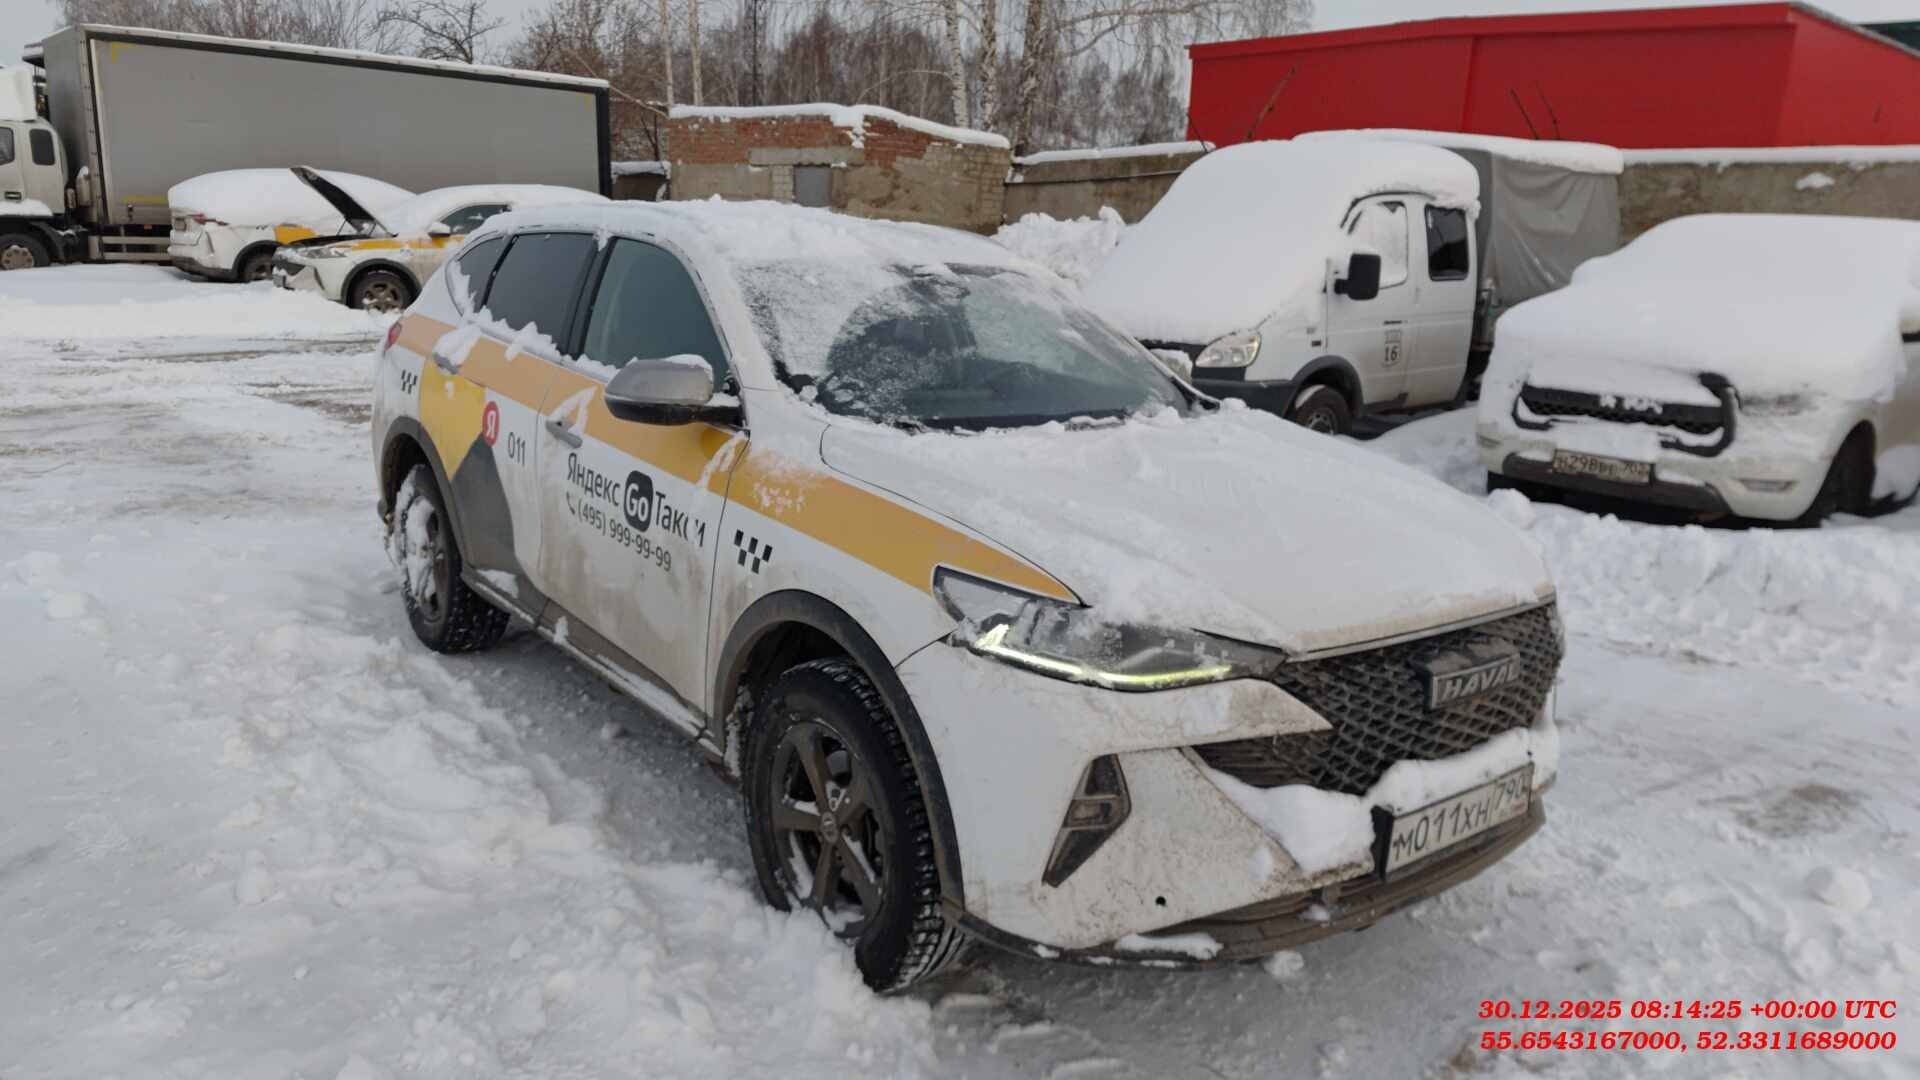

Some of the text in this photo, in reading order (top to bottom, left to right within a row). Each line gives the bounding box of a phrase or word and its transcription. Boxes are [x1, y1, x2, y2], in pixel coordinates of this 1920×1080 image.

[485, 410, 497, 439] Я
[508, 431, 526, 467] 011
[567, 452, 621, 507] Яндекс
[625, 482, 650, 523] Go
[578, 498, 672, 572] (495) 999-99-99
[1441, 662, 1519, 701] HAVAL
